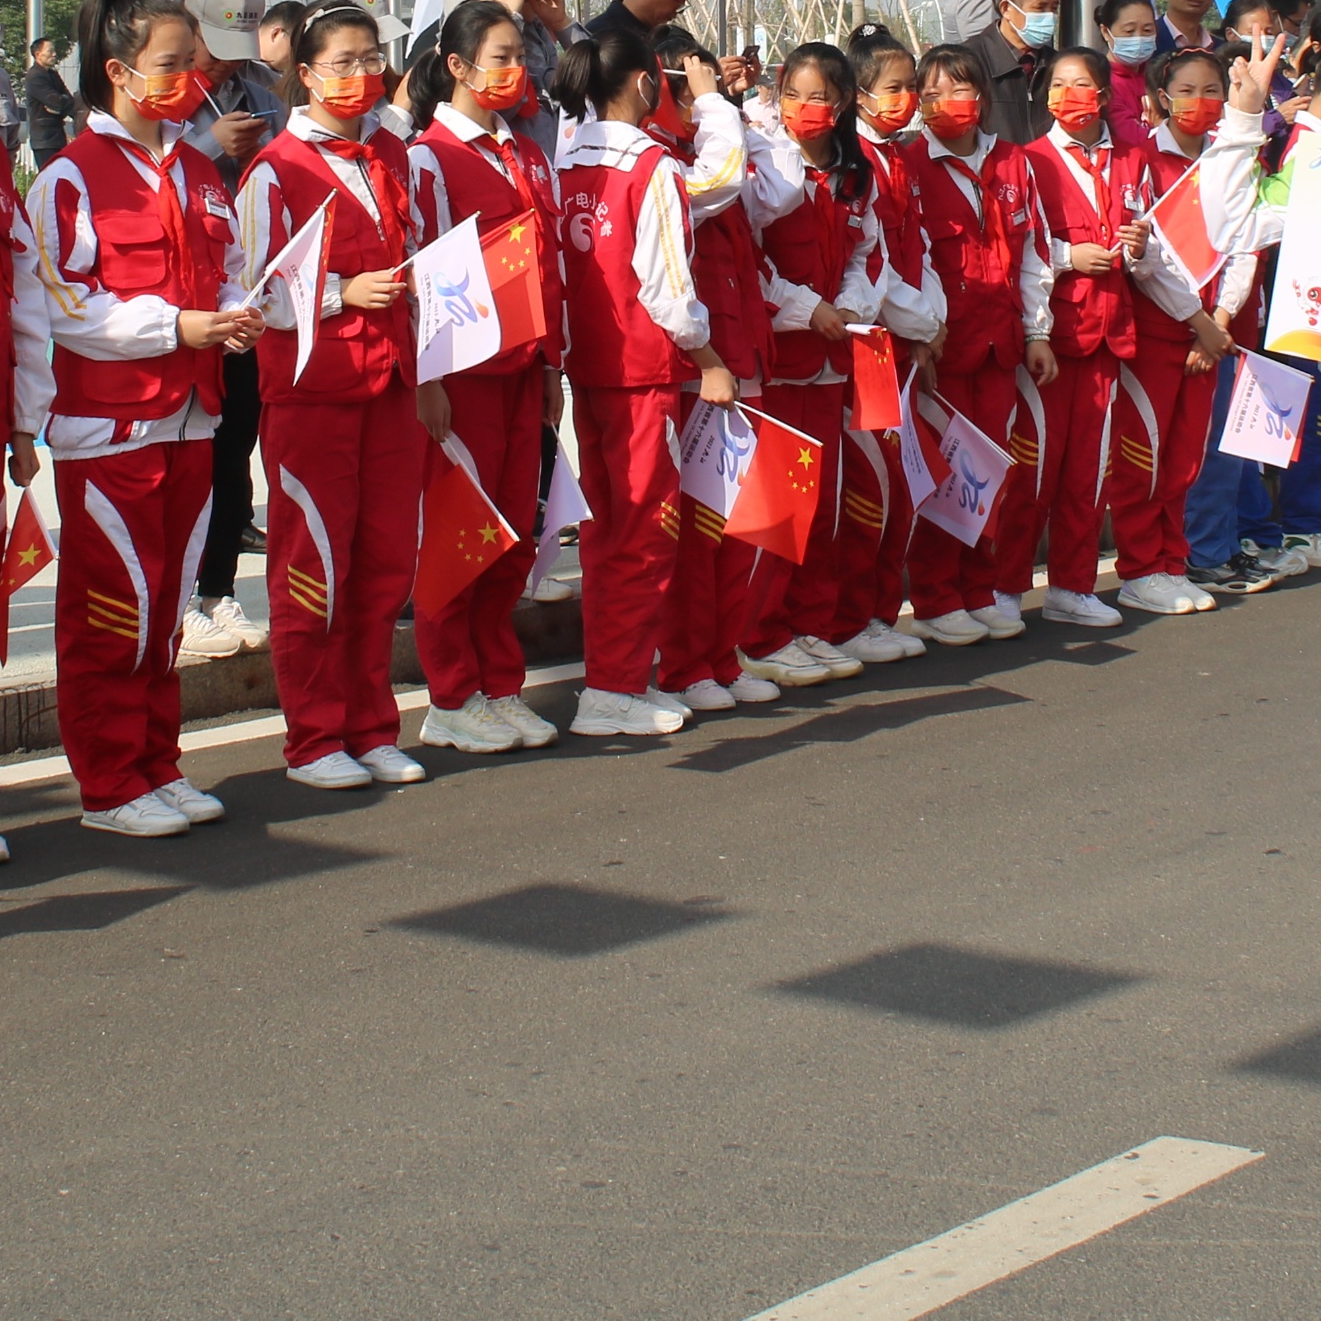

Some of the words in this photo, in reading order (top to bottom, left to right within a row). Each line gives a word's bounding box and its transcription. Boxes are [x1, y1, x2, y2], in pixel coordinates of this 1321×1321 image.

[683, 404, 716, 464] 西省第十六届运动会
